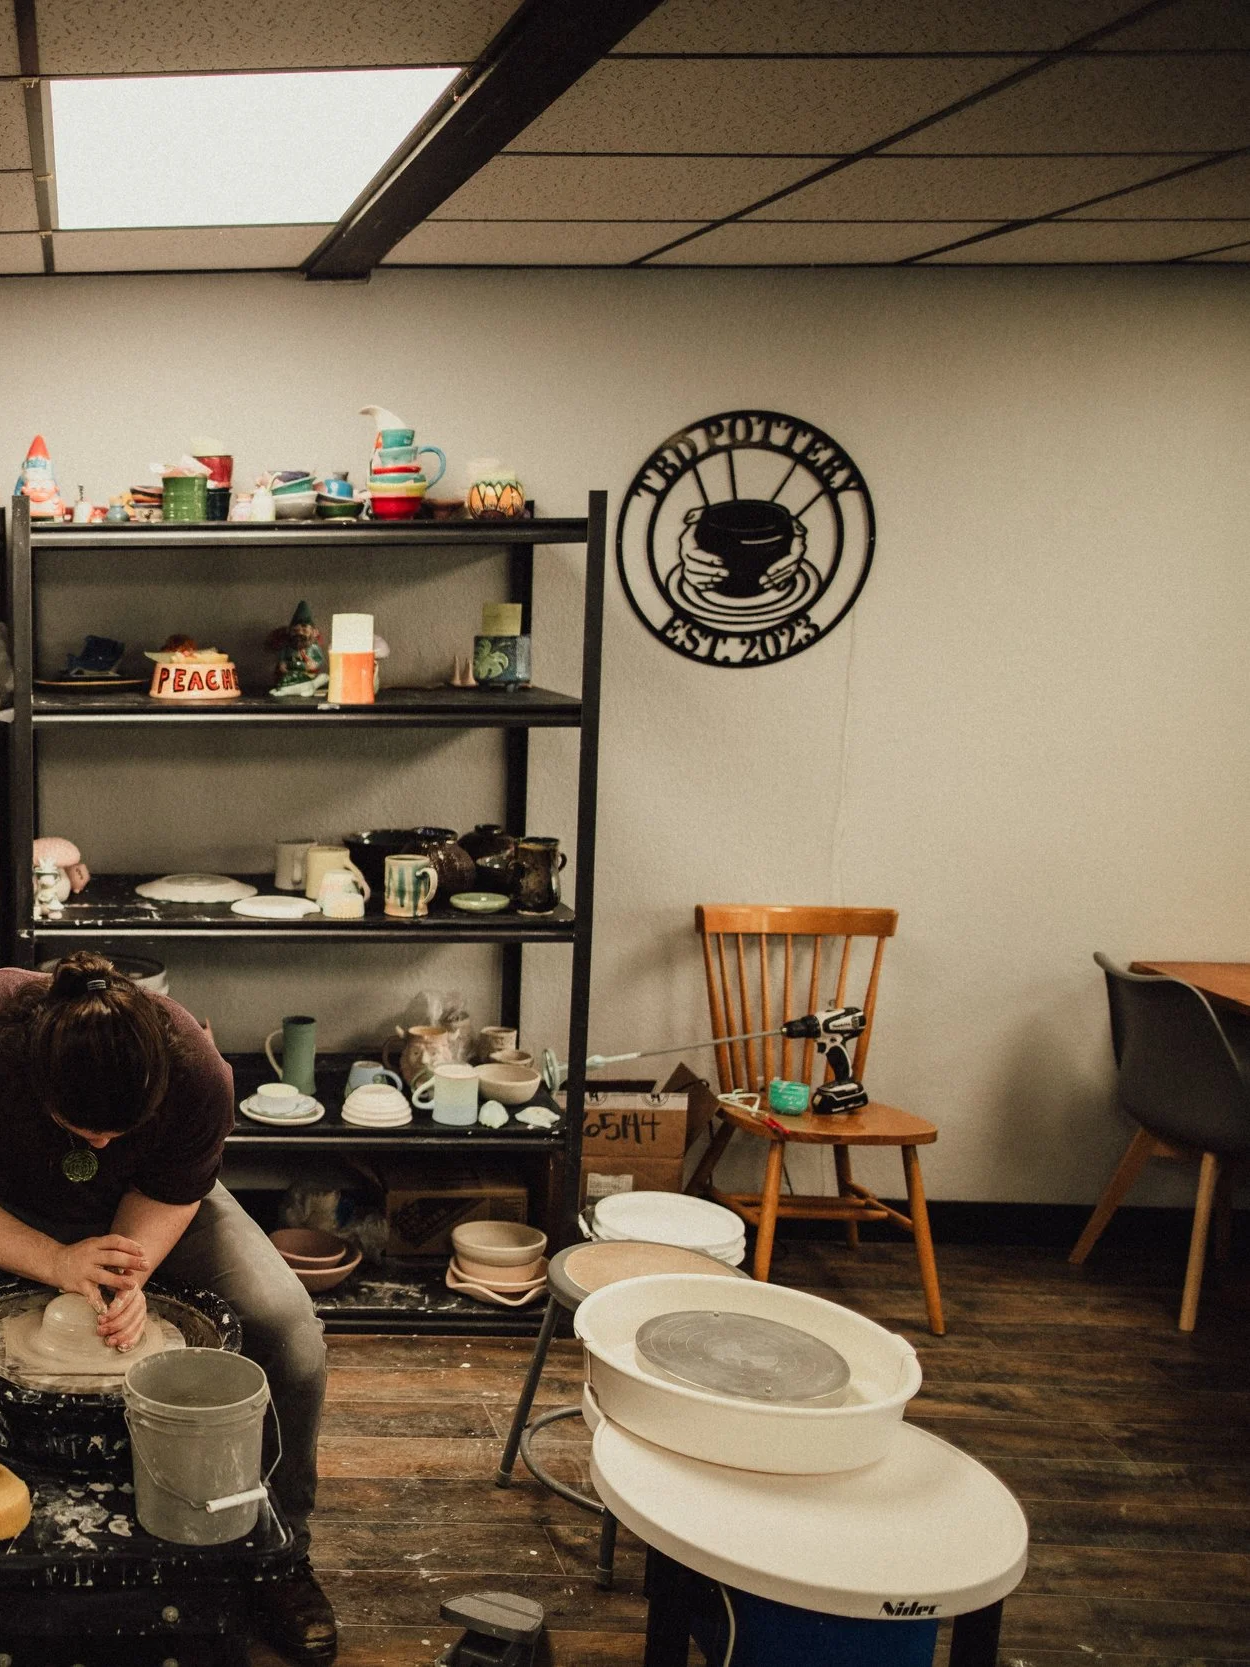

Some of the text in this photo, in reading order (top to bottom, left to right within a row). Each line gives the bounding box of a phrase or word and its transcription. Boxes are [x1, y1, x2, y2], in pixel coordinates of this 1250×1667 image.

[631, 415, 860, 498] TBD POTTERY
[740, 612, 821, 664] 2023
